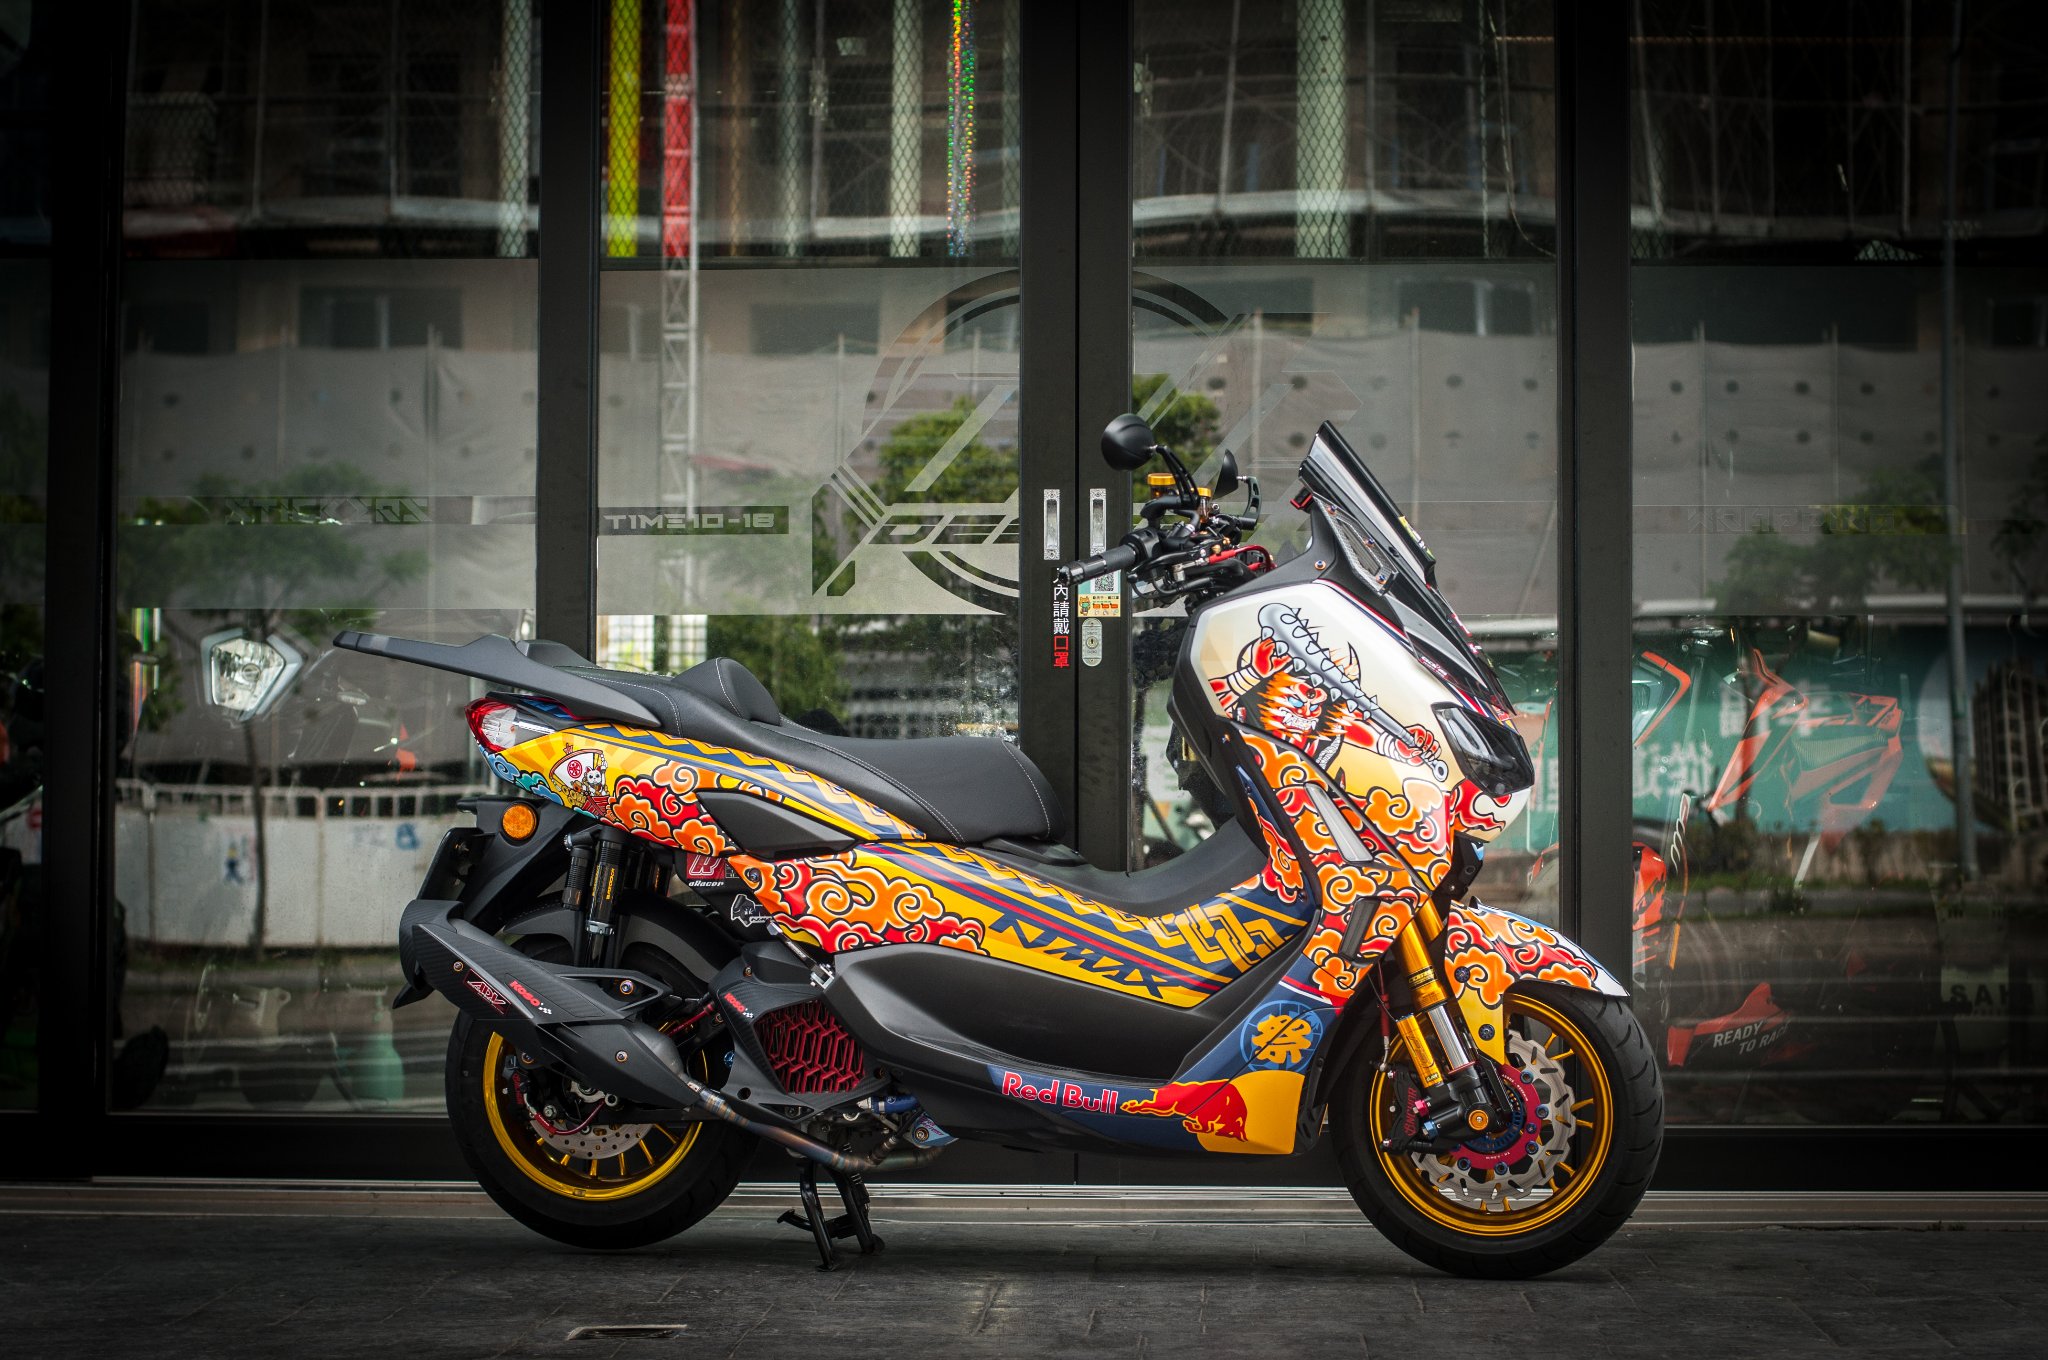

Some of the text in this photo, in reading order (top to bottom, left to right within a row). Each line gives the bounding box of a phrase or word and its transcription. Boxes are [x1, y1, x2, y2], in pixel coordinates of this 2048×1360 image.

[603, 513, 775, 530] TIME10-18
[509, 980, 541, 1007] KOSO
[724, 992, 745, 1013] KOSO
[1251, 1014, 1312, 1064] 祭
[1713, 1020, 1764, 1048] READY
[1739, 1041, 1756, 1055] TO
[1001, 1071, 1119, 1115] Red Bull
